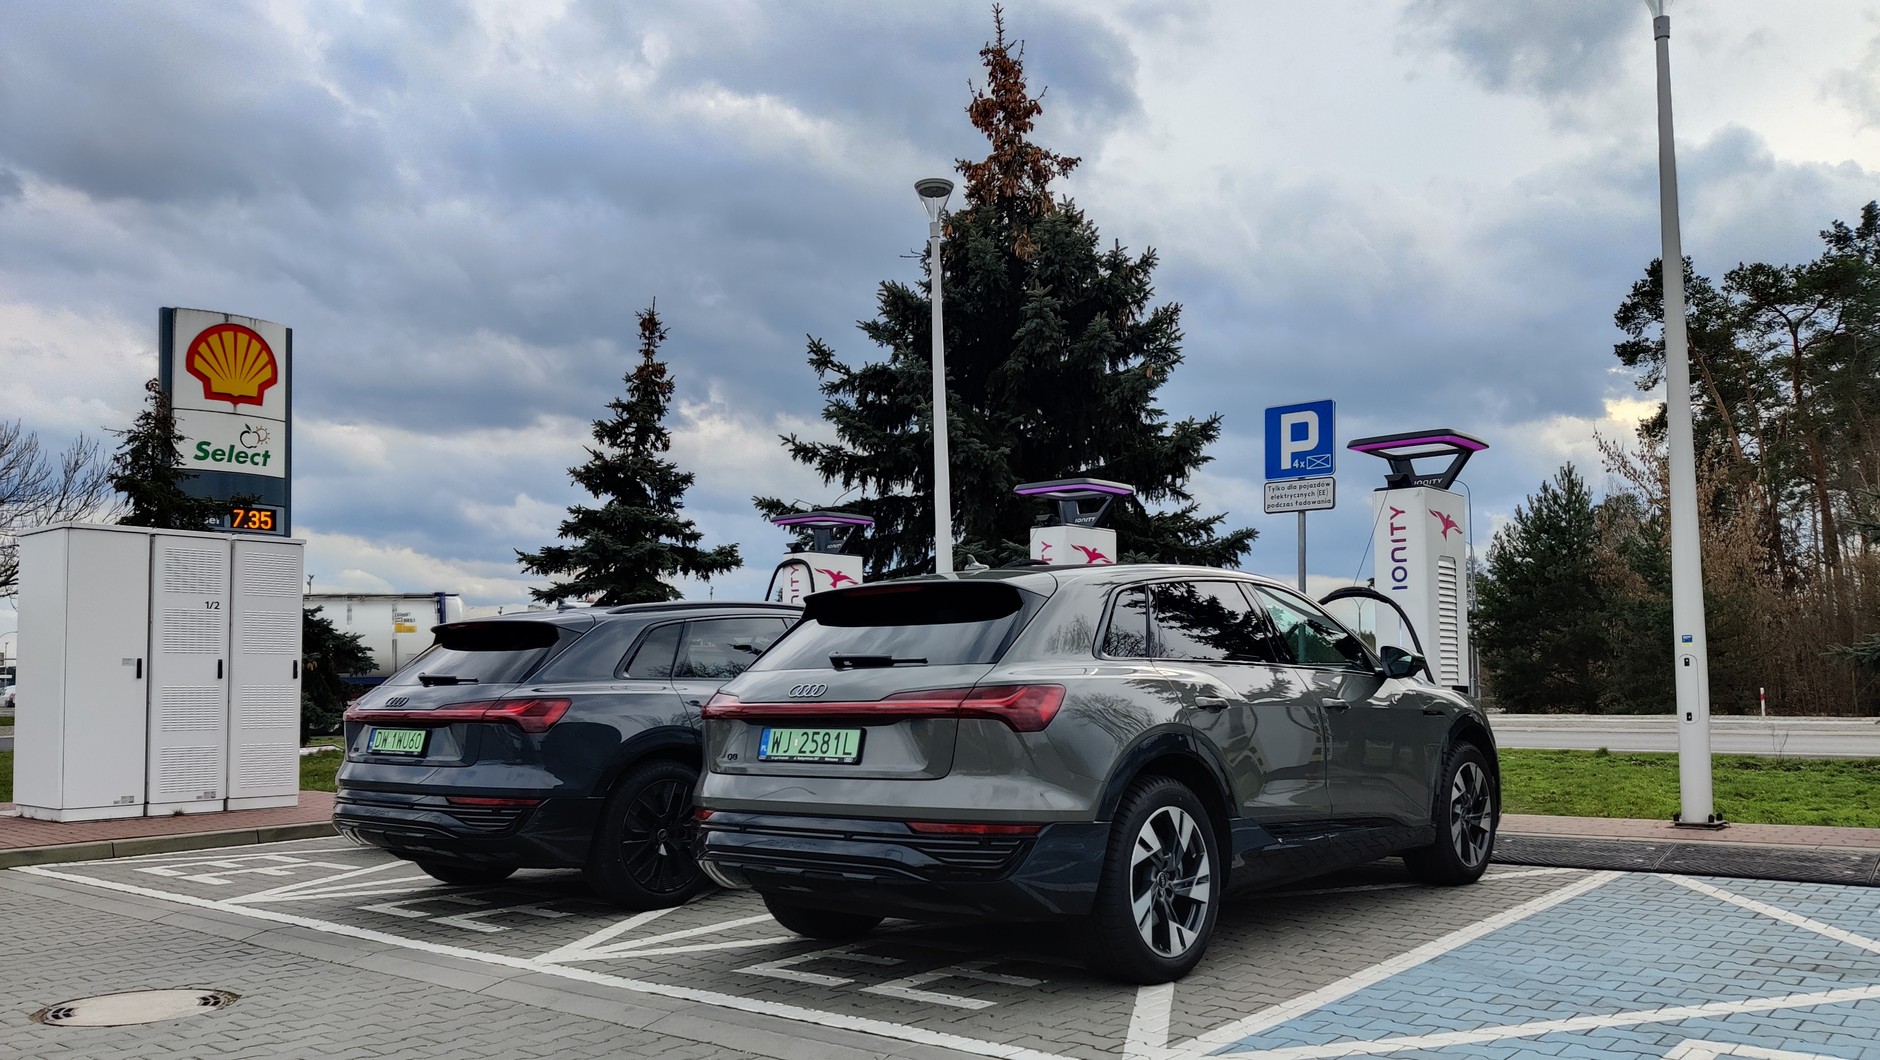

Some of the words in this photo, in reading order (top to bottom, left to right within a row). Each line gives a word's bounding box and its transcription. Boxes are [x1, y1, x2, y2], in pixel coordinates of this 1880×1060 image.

[1281, 410, 1319, 470] P
[193, 441, 271, 467] Select
[1292, 459, 1305, 469] 4x
[1267, 485, 1285, 493] Tylko
[1298, 481, 1331, 491] pojazdów
[1413, 477, 1444, 486] IONITY
[1270, 490, 1315, 500] elektrycznych
[1317, 488, 1329, 497] (EE)
[1266, 501, 1294, 510] podczas
[233, 509, 272, 529] 7.35
[1389, 505, 1408, 590] IONITY
[204, 601, 221, 610] 1/2
[374, 731, 390, 748] DW
[771, 730, 793, 754] WJ
[798, 731, 853, 756] 2581L
